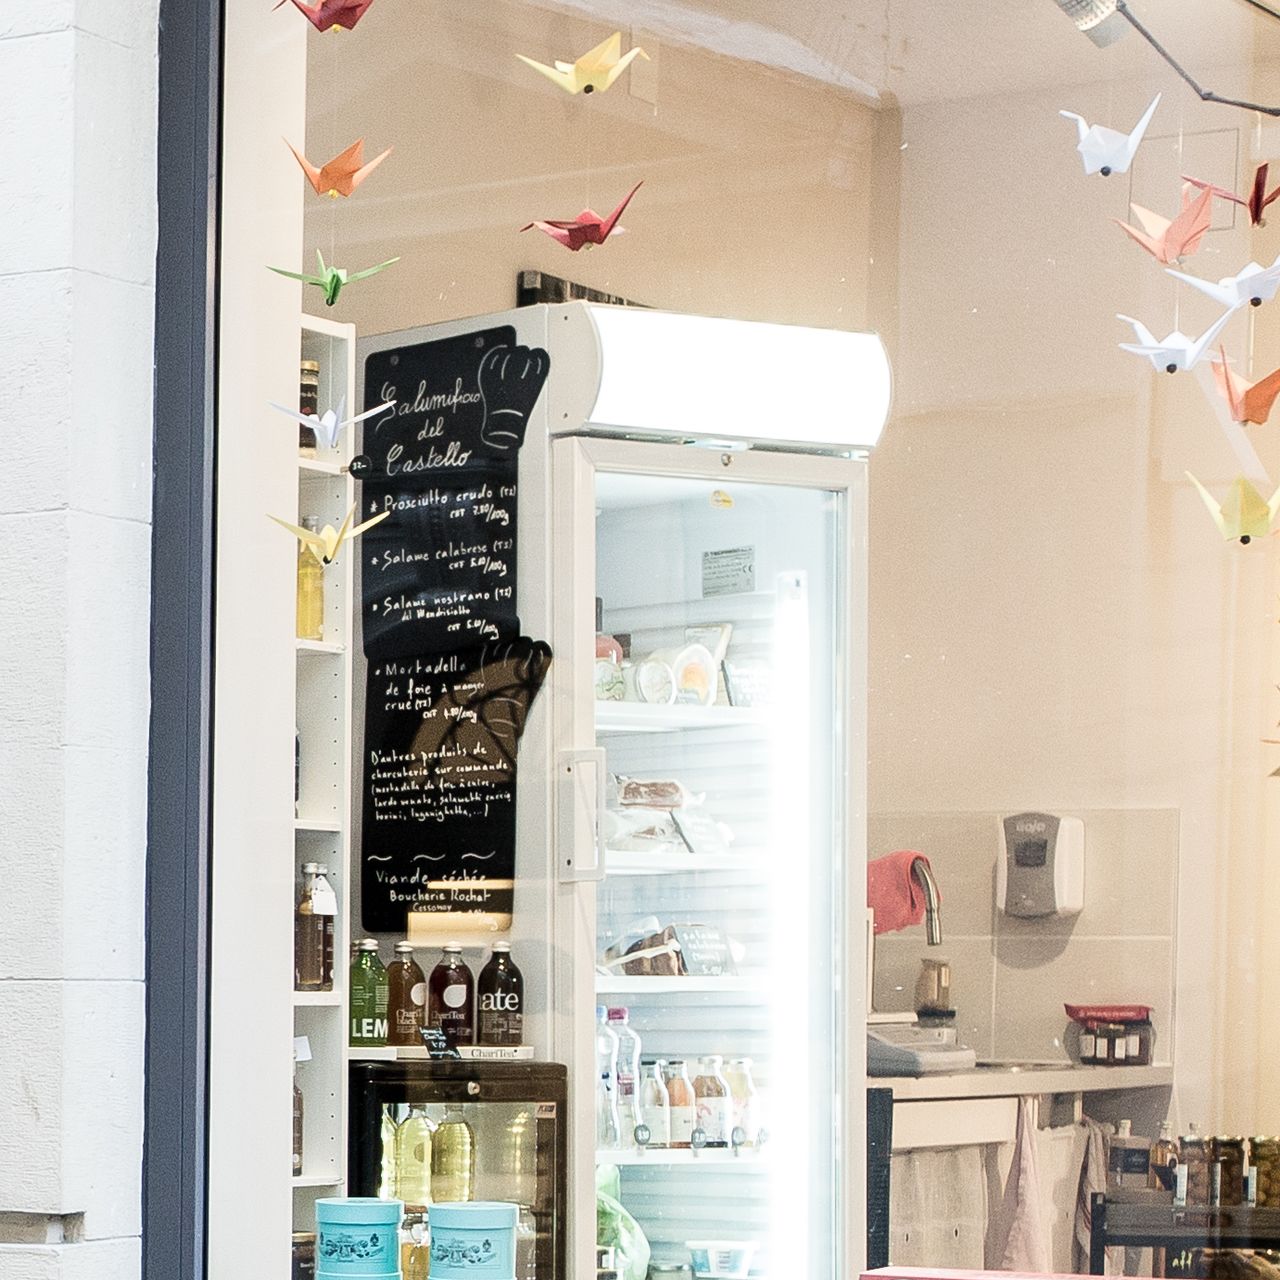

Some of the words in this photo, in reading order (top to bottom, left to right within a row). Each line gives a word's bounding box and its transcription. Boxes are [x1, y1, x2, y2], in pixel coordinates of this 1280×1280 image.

[417, 416, 444, 441] del
[386, 440, 472, 477] Castello
[384, 488, 448, 511] Prosciutto
[455, 483, 493, 503] crudo
[381, 548, 430, 571] Salame
[435, 541, 488, 560] calabrese
[382, 595, 427, 617] Salame
[433, 591, 490, 606] nostrano
[385, 655, 467, 676] Mortadella
[385, 684, 399, 696] de
[407, 677, 433, 700] foie
[440, 683, 448, 693] à
[385, 699, 412, 711] crue
[371, 749, 416, 765] D'autres
[421, 743, 468, 767] produits
[473, 741, 488, 755] de
[371, 766, 429, 781] charcuterie
[434, 765, 453, 775] sur
[455, 758, 509, 773] commande
[424, 779, 435, 791] de
[375, 866, 429, 885] Viande
[389, 889, 446, 903] Boucherie
[450, 887, 492, 902] Rochat
[352, 1018, 388, 1038] LEM
